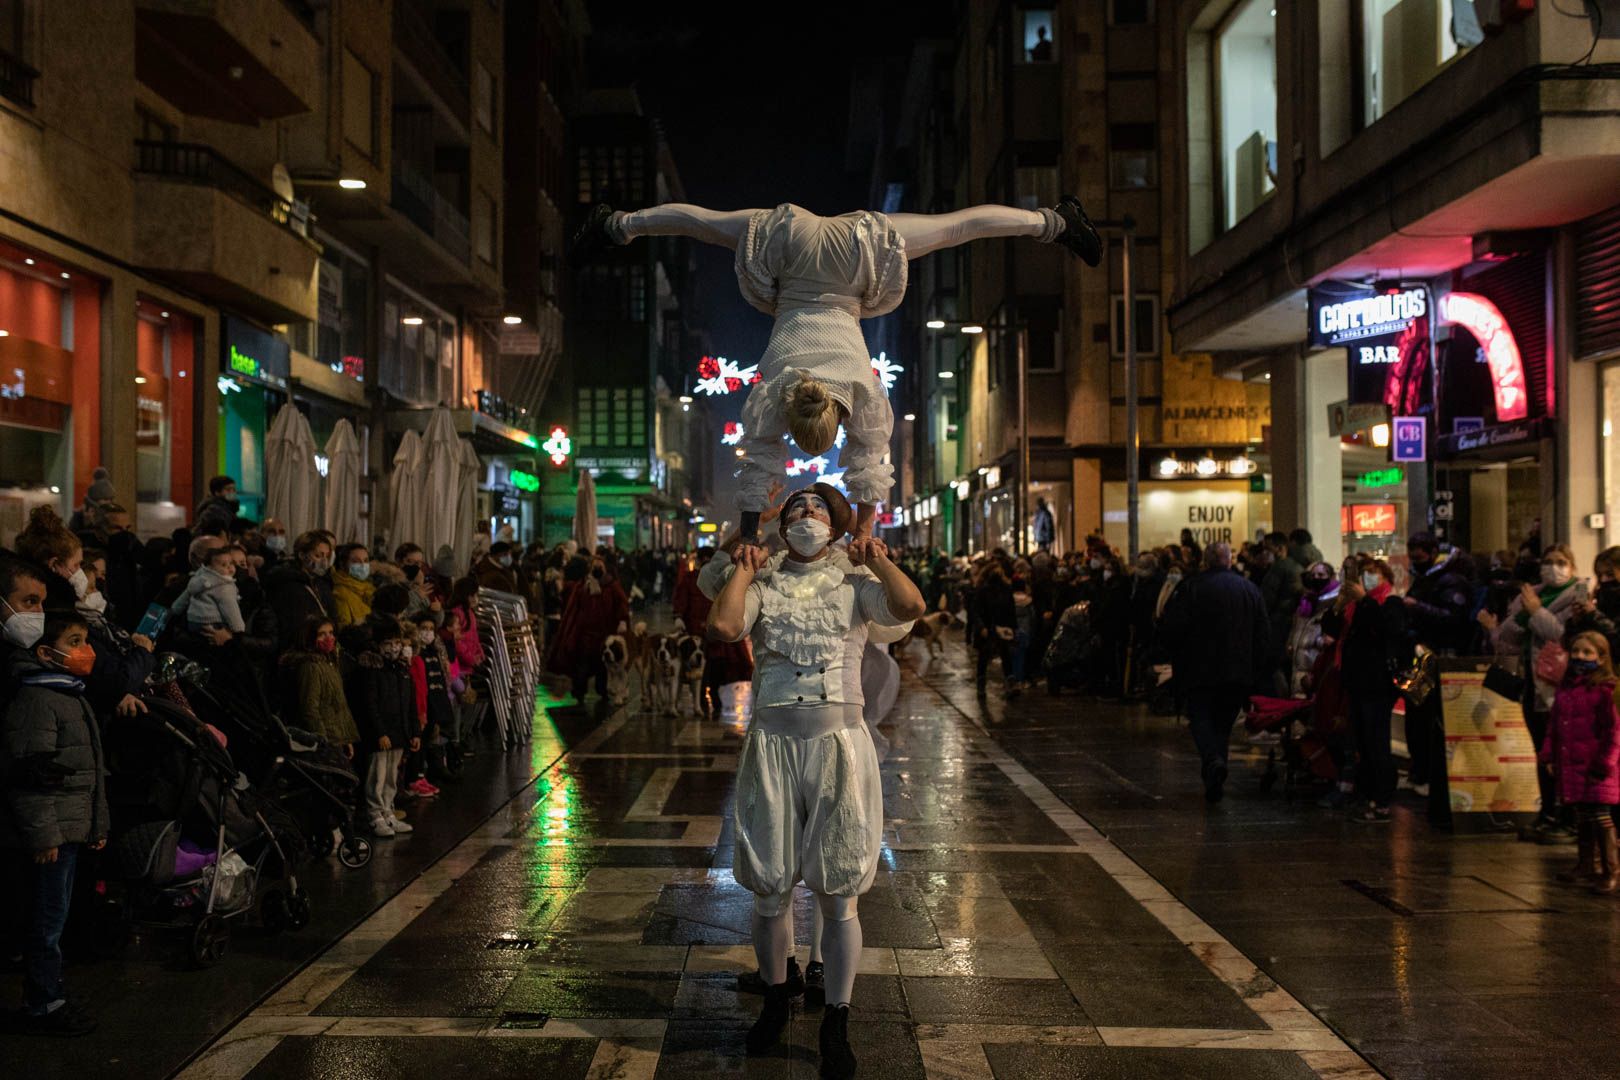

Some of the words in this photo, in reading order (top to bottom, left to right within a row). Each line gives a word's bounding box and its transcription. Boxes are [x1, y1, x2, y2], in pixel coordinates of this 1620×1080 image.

[1360, 346, 1401, 364] BAR
[1164, 405, 1258, 419] ALMACENES
[1399, 425, 1421, 442] CB
[1189, 505, 1234, 523] ENJOY
[1191, 527, 1232, 545] YOUR
